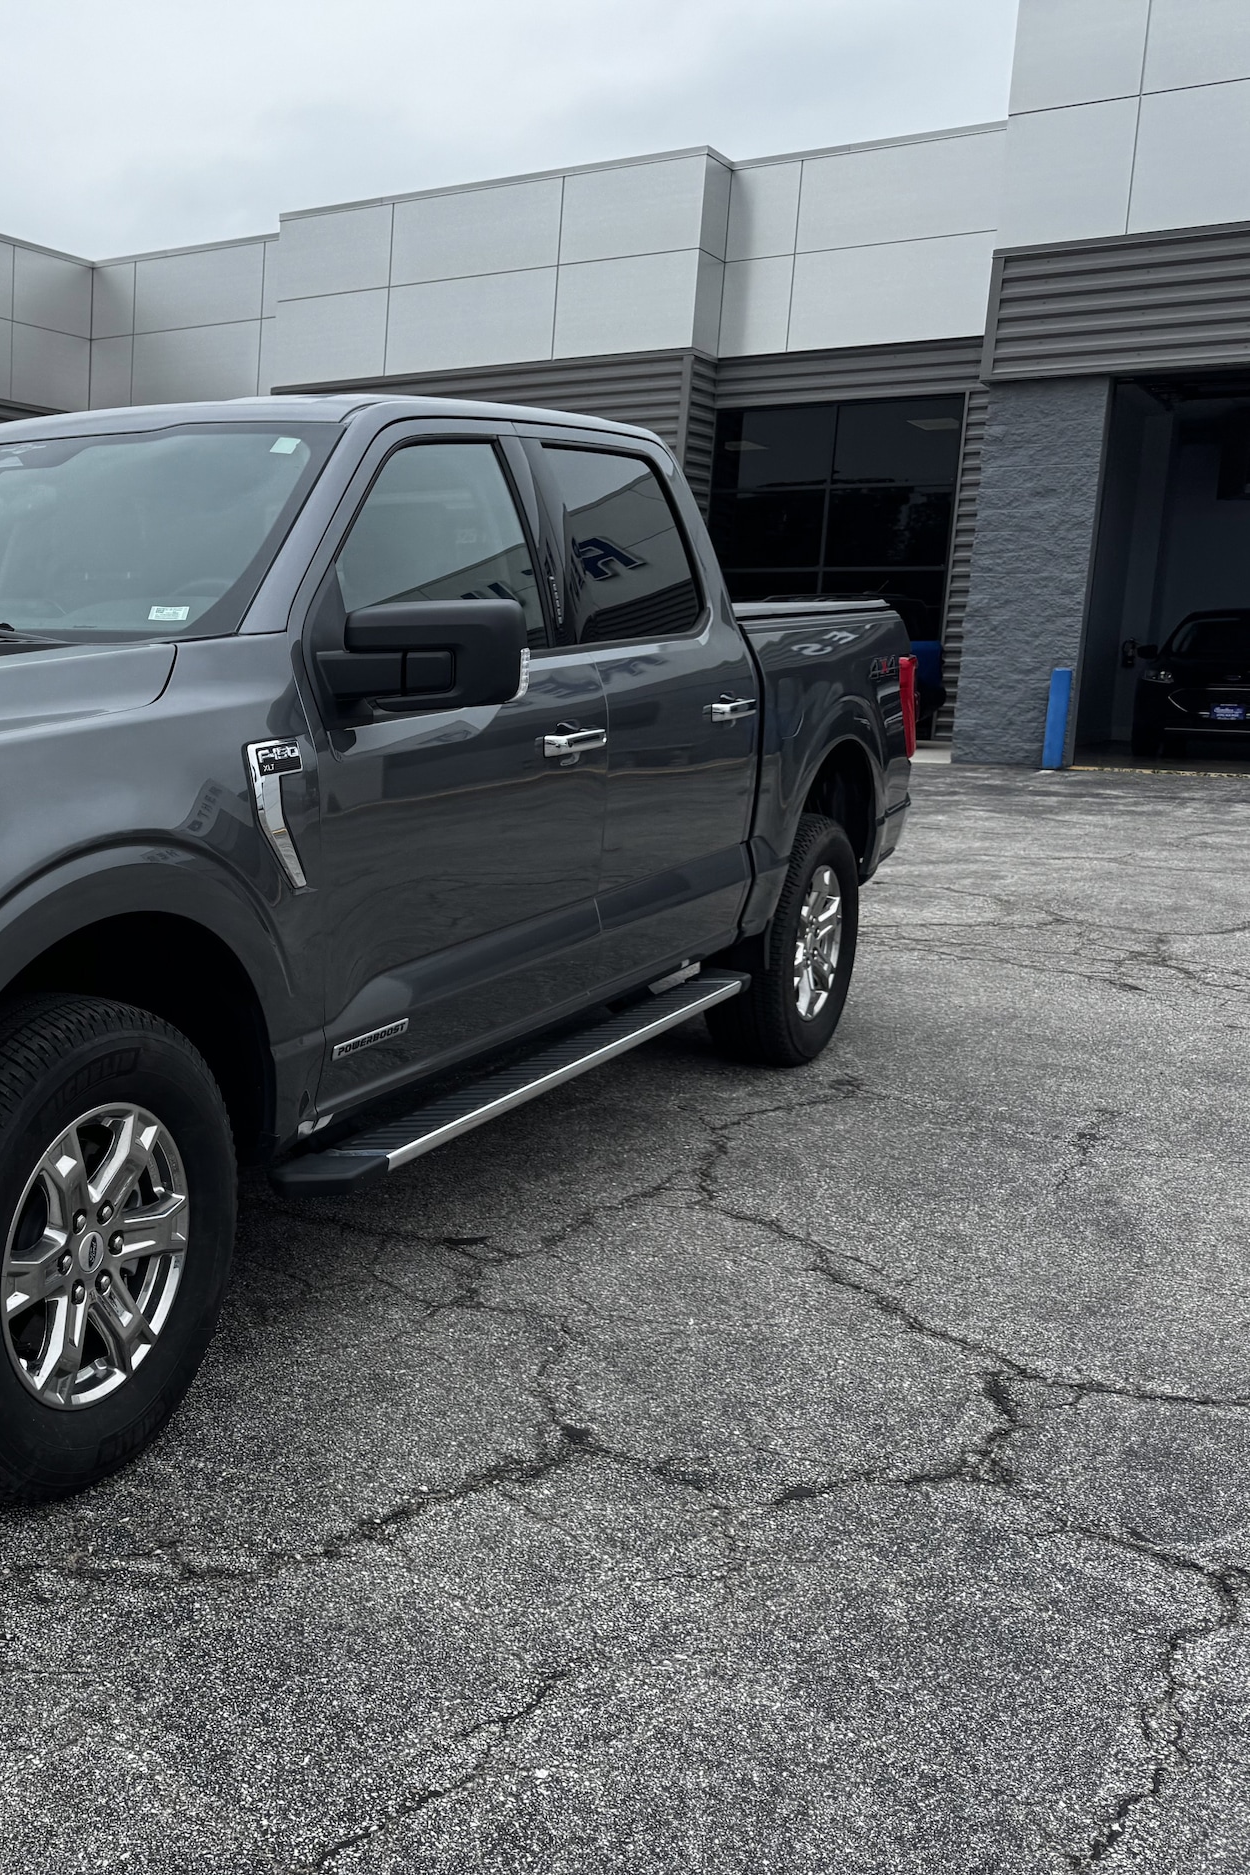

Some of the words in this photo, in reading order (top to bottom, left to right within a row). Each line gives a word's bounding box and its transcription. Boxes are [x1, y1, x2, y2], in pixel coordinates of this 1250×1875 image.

[257, 746, 299, 763] F-150
[263, 763, 275, 772] XLT
[337, 1022, 406, 1056] POWERBOOST
